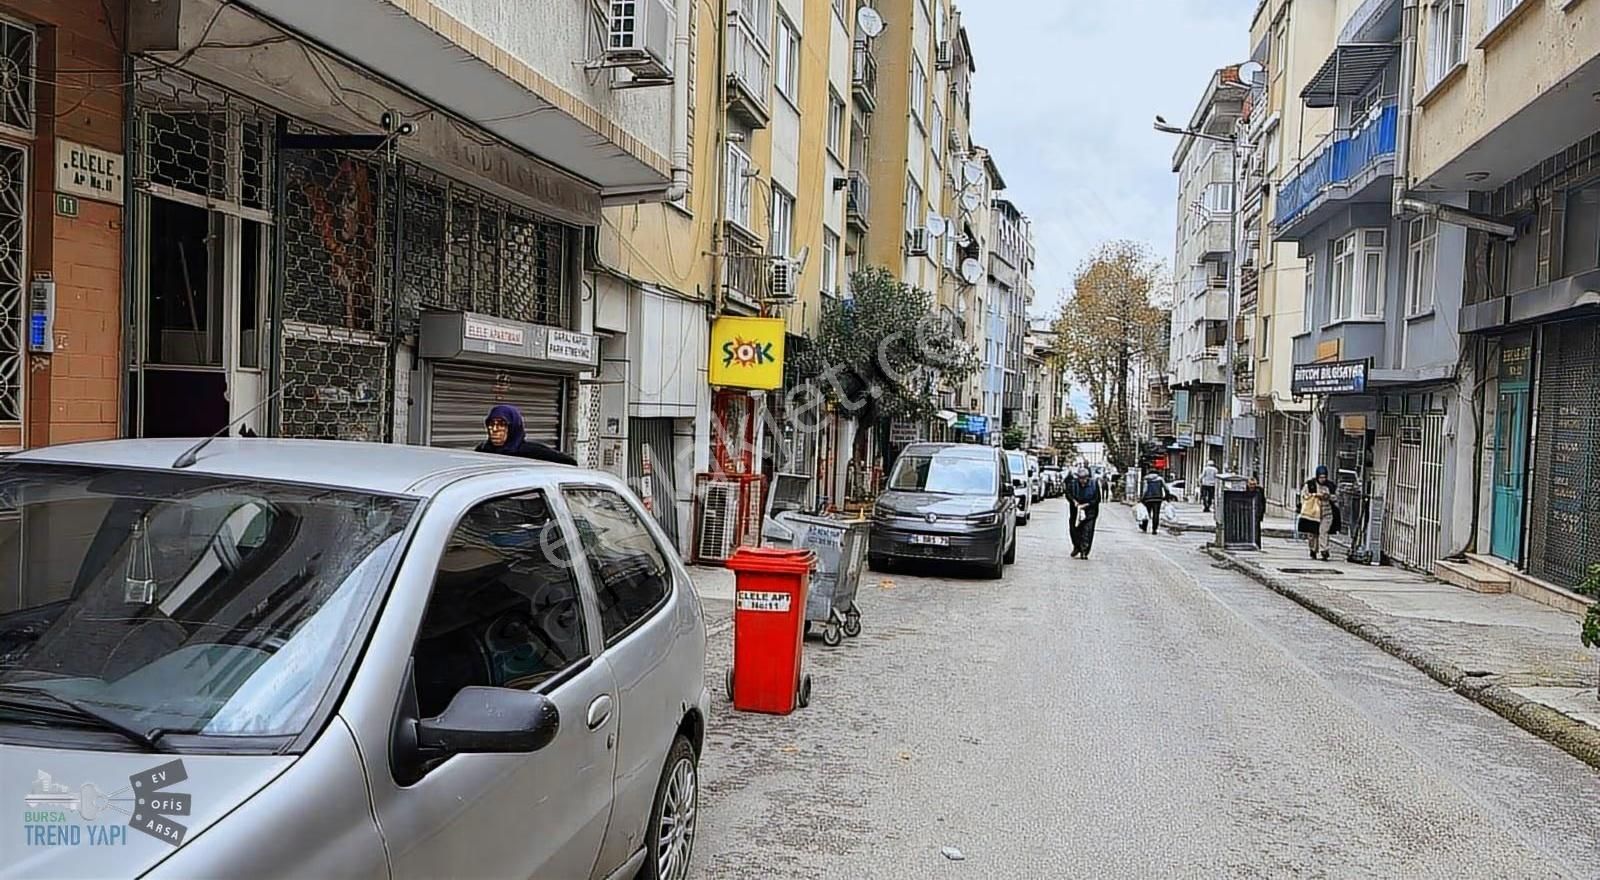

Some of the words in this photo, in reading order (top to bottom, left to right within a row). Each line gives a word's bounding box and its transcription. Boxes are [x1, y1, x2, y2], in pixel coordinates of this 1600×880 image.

[71, 150, 114, 176] ELELE
[74, 172, 86, 185] AP
[63, 198, 73, 213] 11
[723, 336, 775, 368] ŞOK
